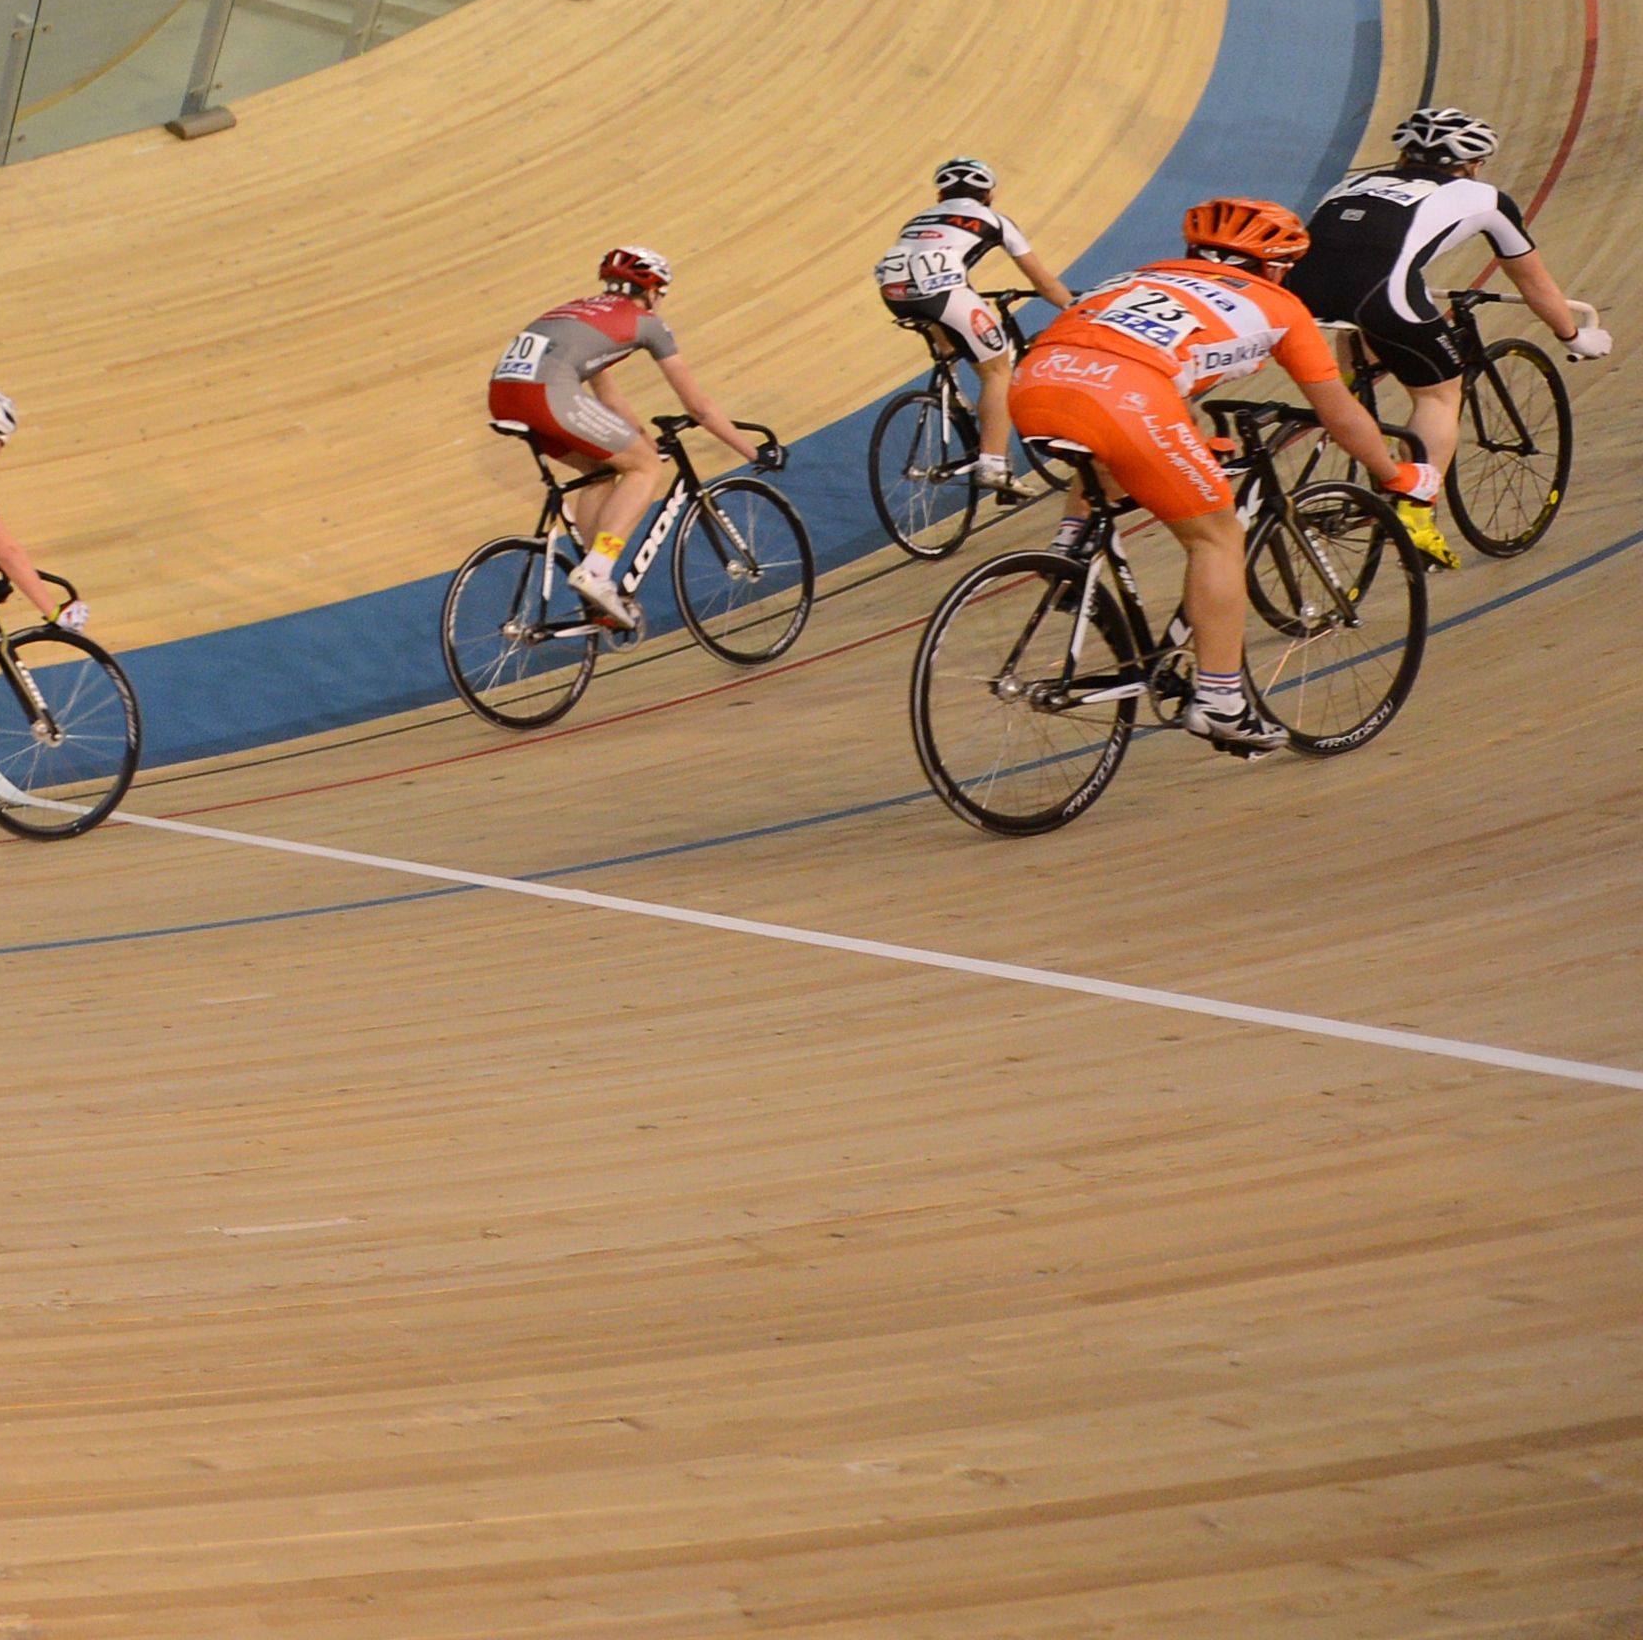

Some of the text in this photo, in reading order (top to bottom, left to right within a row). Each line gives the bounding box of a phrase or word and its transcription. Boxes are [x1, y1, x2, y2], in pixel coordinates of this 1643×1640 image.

[918, 251, 952, 276] 12
[1128, 291, 1192, 323] 23
[506, 335, 535, 360] 20
[1204, 340, 1270, 370] Dalkia
[621, 478, 689, 594] LOOK
